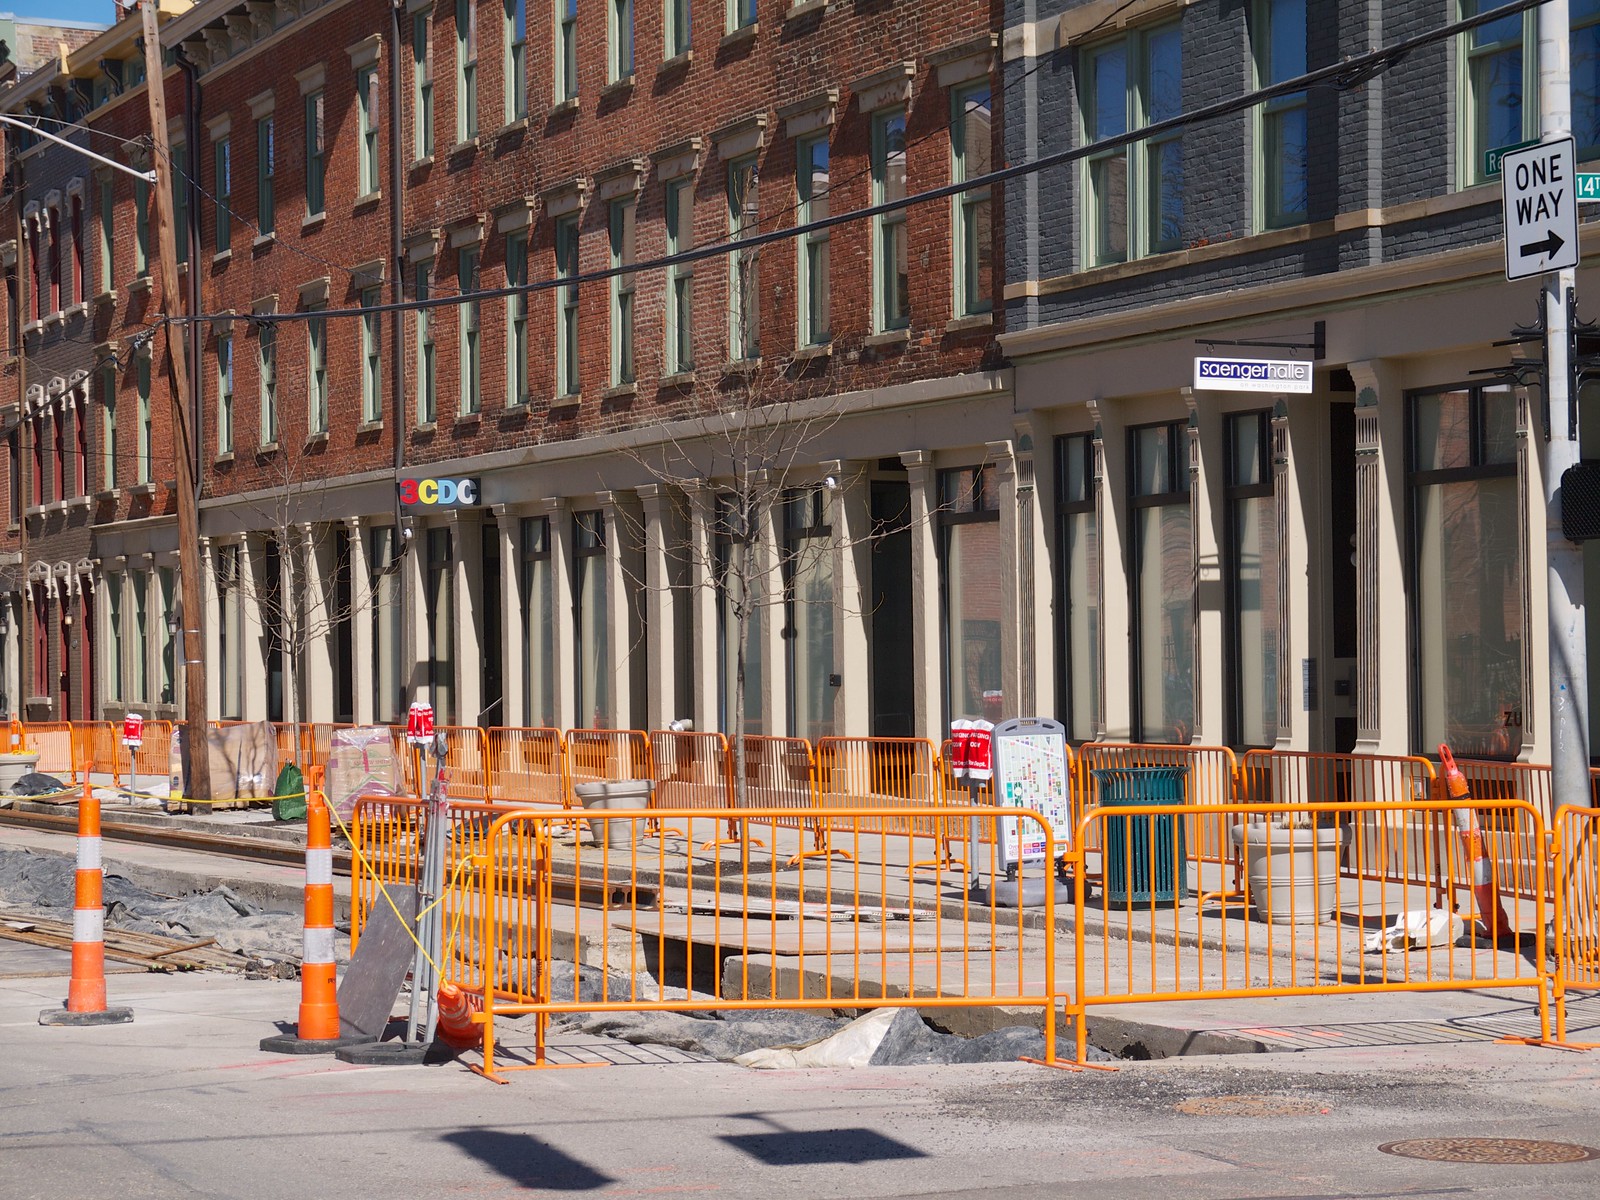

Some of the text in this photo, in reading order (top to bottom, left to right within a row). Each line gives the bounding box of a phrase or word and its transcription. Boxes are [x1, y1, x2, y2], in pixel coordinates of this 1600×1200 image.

[1516, 154, 1562, 191] ONE
[1516, 189, 1563, 226] WAY
[1202, 362, 1305, 380] saengerhalle
[400, 479, 477, 505] 3CDC
